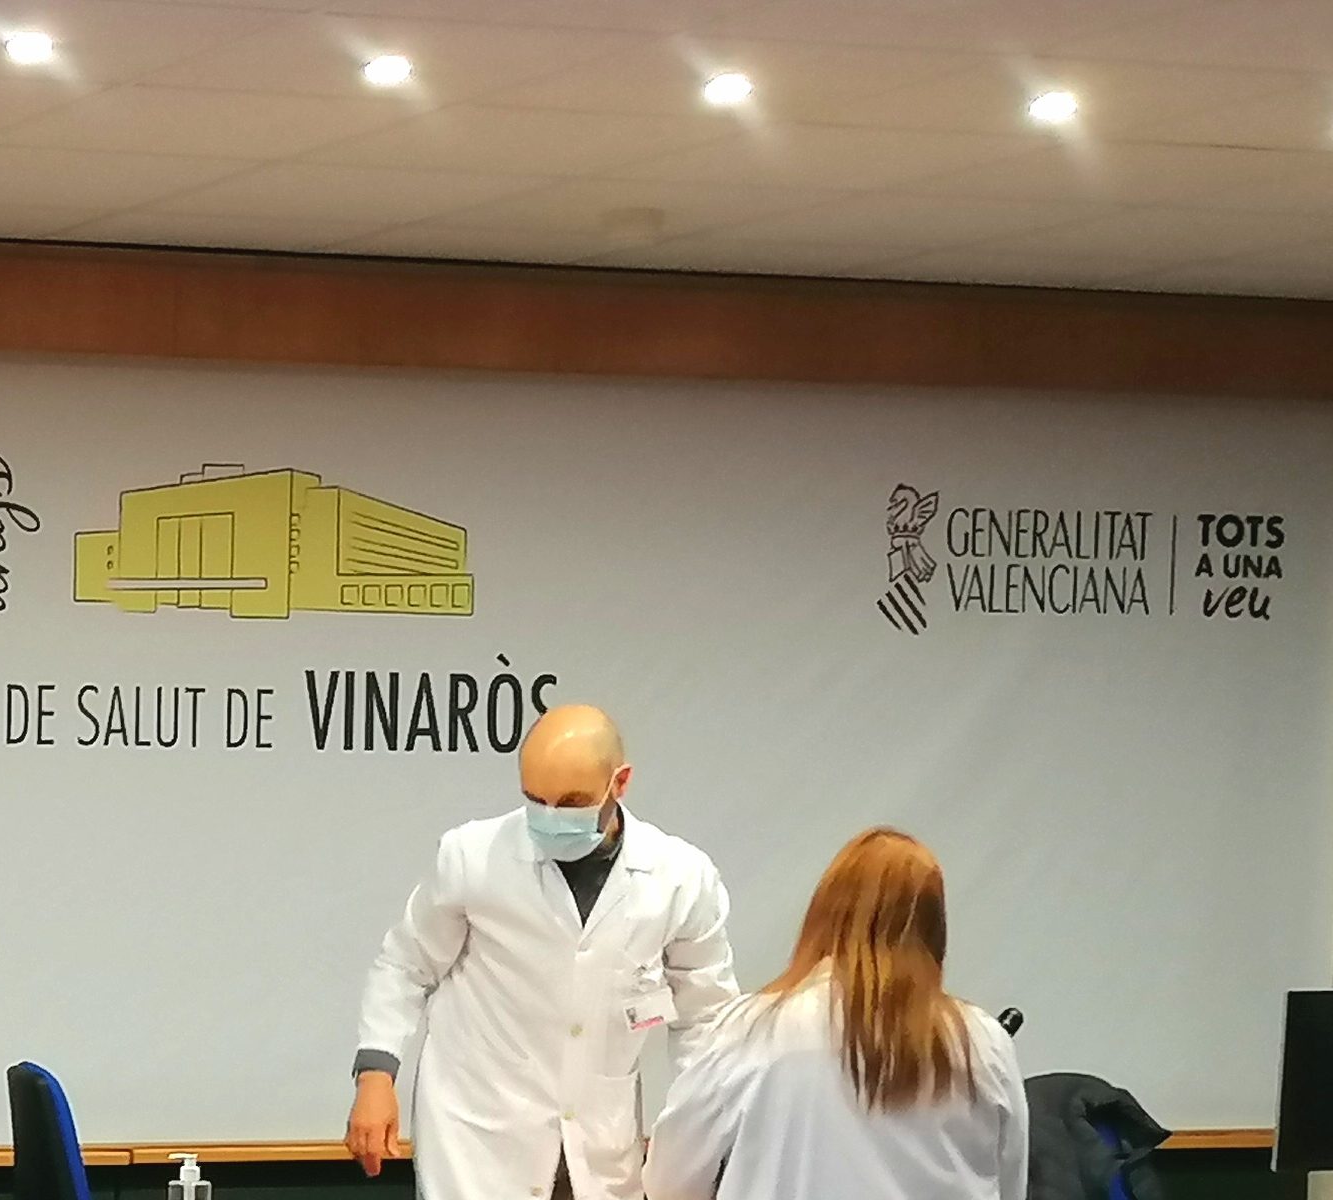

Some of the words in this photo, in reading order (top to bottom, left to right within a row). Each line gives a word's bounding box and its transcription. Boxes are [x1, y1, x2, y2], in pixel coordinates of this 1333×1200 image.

[946, 507, 1153, 560] GENERALITAT
[1197, 514, 1285, 549] TOTS
[946, 562, 1150, 615] VALENCIANA
[1195, 554, 1214, 578] A
[1223, 554, 1283, 579] UNA
[1203, 585, 1271, 620] veu
[6, 681, 56, 747] DE
[76, 683, 207, 749] SALUT
[225, 687, 275, 749] DE
